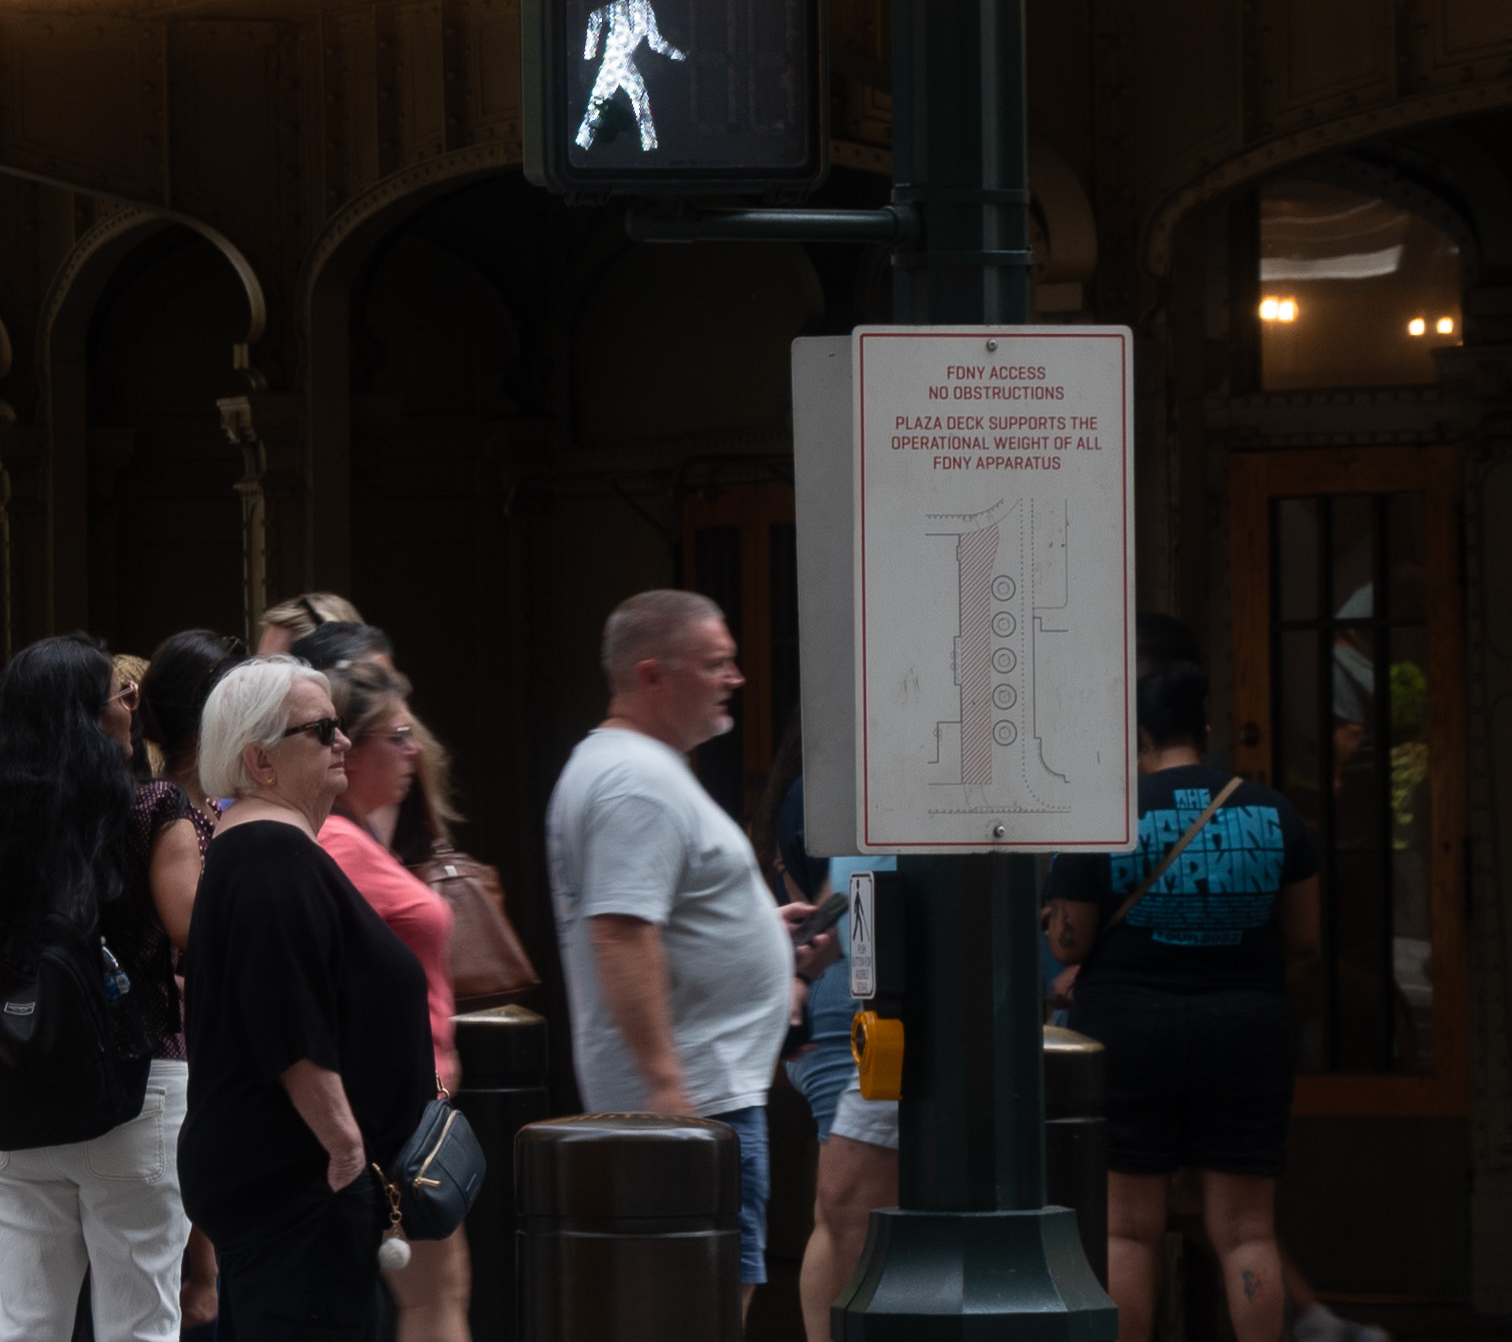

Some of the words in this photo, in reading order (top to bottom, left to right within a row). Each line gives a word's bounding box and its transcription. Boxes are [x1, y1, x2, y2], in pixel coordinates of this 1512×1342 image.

[947, 366, 985, 380] FDNY
[989, 366, 1046, 380] ACCESS
[929, 386, 949, 400] NO
[953, 386, 1064, 400] OBSTRUCTIONS
[895, 416, 942, 430] PLAZA
[947, 416, 984, 430] DECK
[988, 416, 1066, 430] SUPPORTS
[1070, 416, 1098, 430] THE
[891, 436, 989, 450] OPERATIONAL
[993, 436, 1049, 450] WEIGHT
[1054, 436, 1072, 450] OF
[1076, 436, 1102, 450] ALL
[933, 456, 971, 471] FDNY
[975, 456, 1061, 471] APPARATUS
[1112, 805, 1285, 857] MASHING
